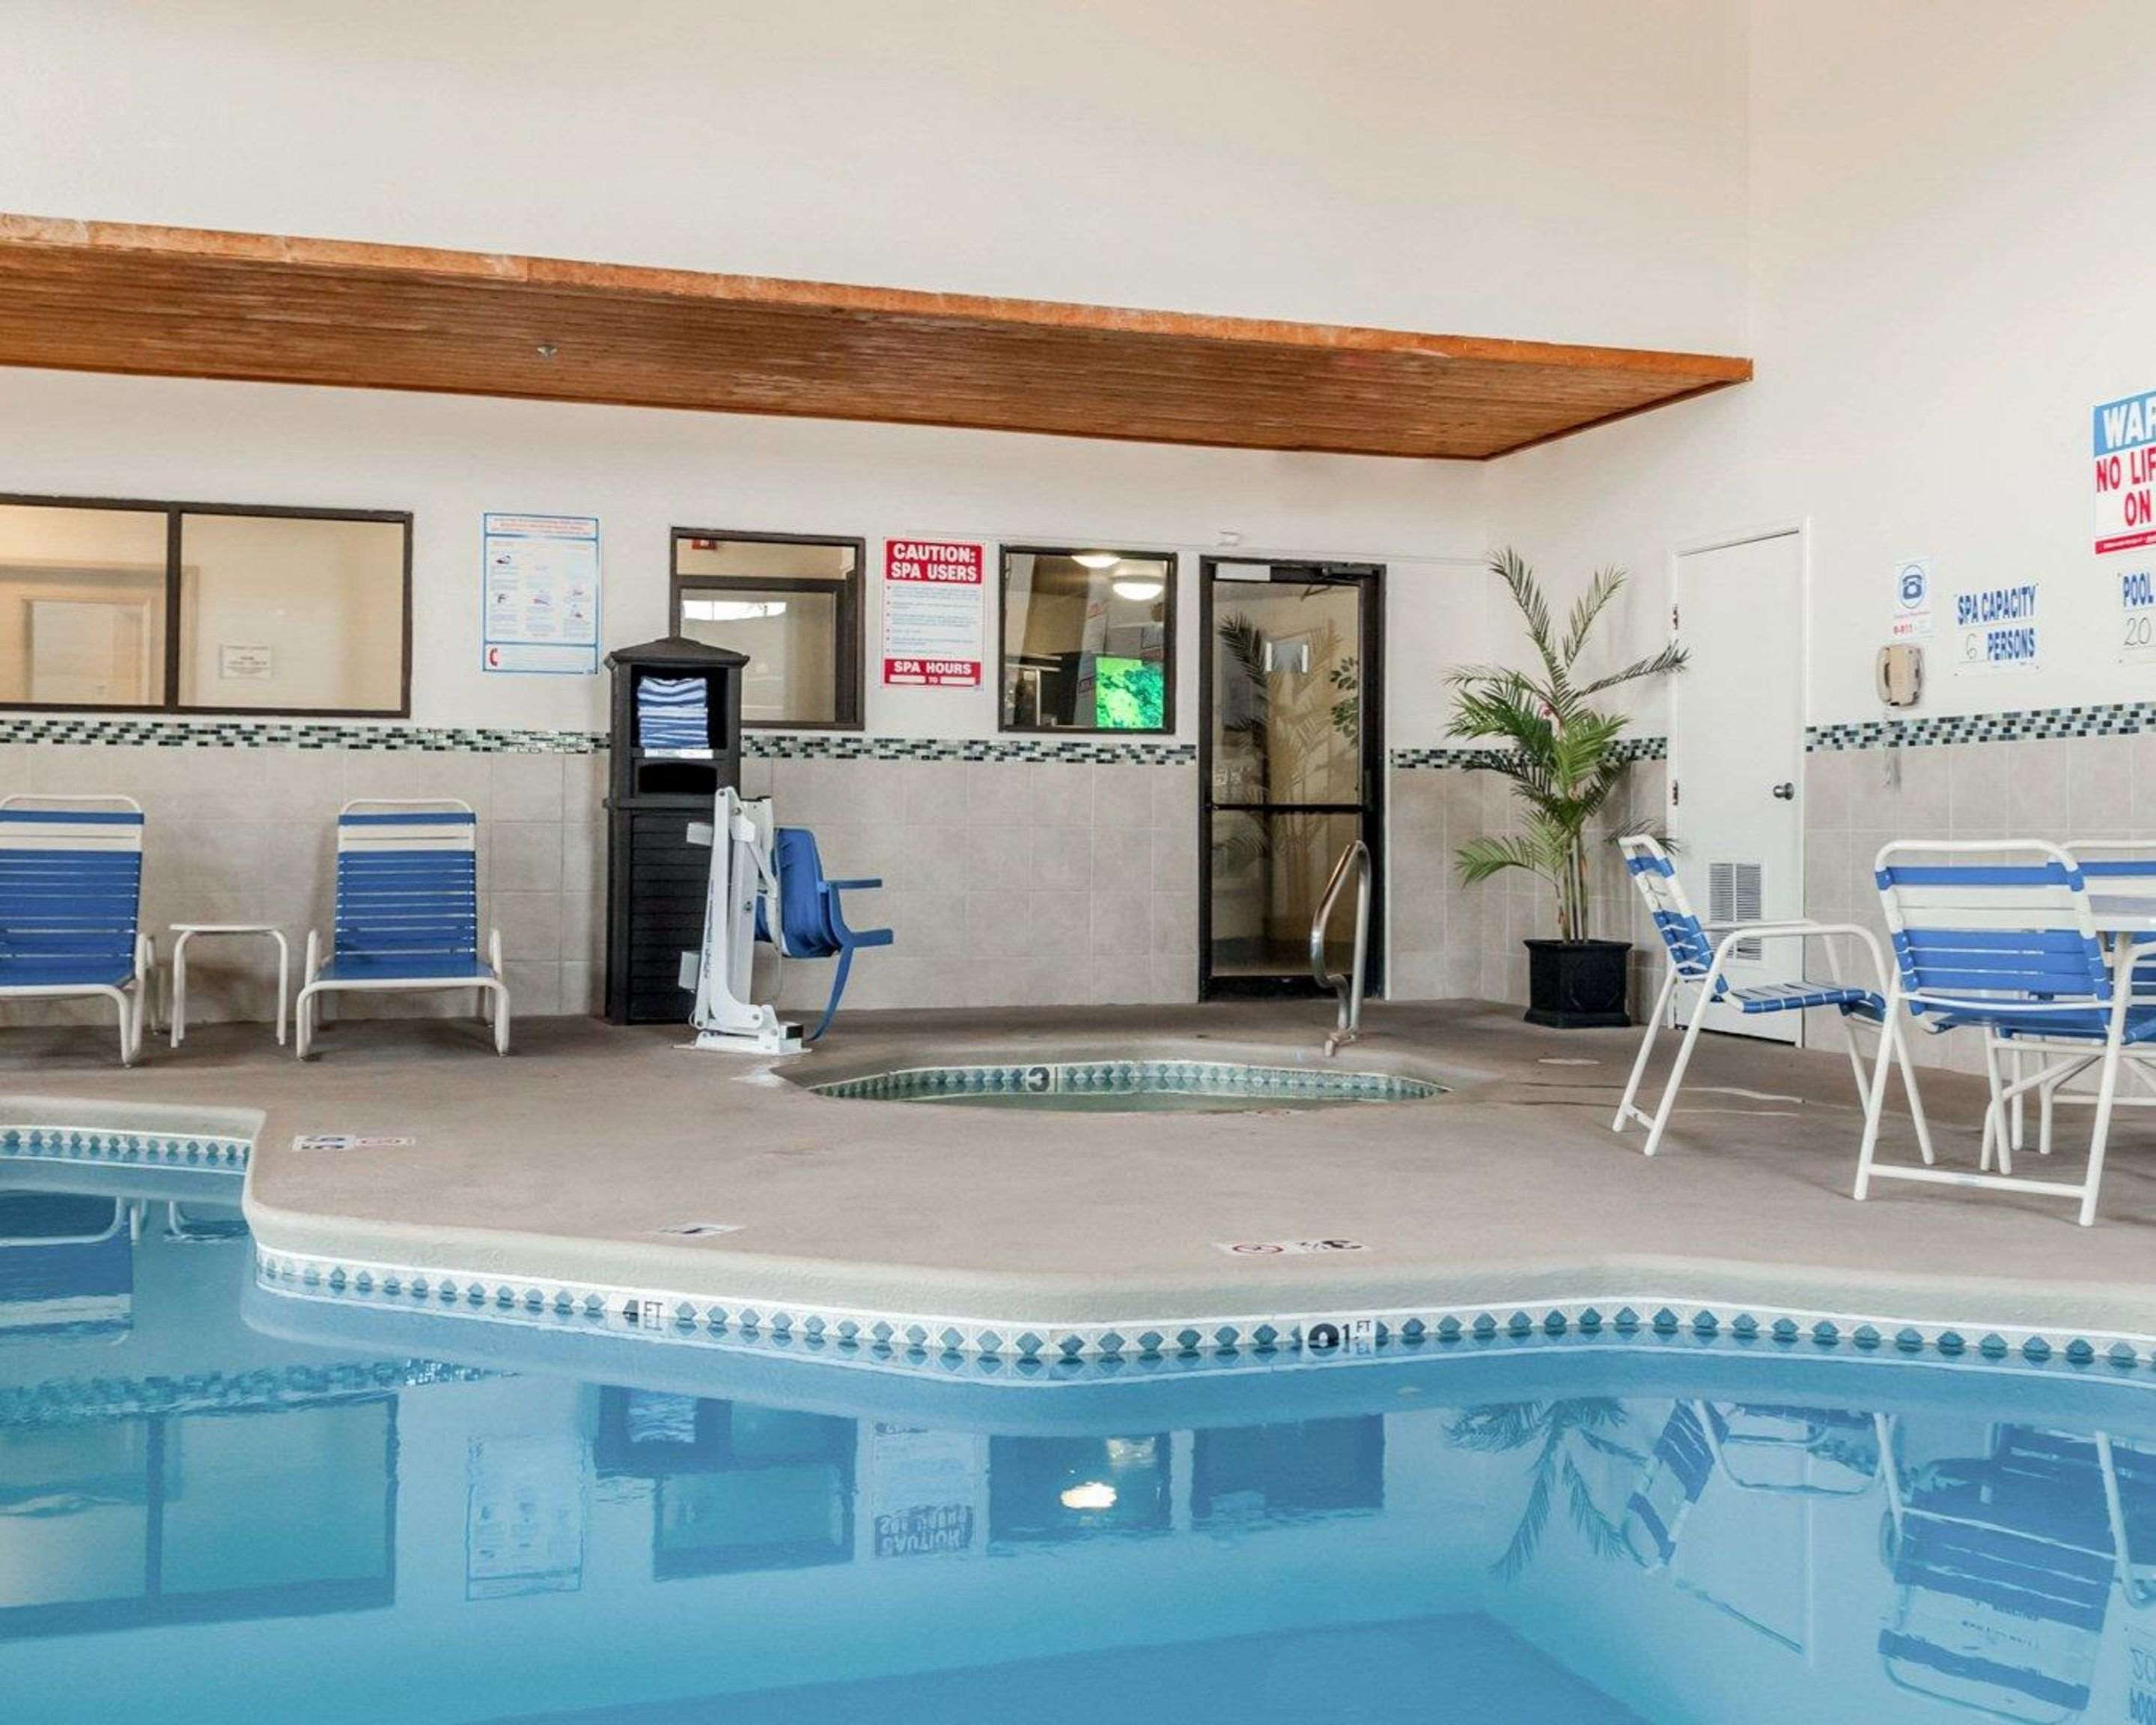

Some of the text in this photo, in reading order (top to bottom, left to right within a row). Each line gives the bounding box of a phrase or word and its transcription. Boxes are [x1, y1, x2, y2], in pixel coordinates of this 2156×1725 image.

[2096, 455, 2121, 493] NO
[2125, 489, 2152, 526] ON
[893, 543, 976, 563] CAUTION:
[891, 562, 977, 581] SPA USERS
[1958, 585, 2035, 625] SPA CAPACITY
[2123, 573, 2154, 607] POOL
[1988, 627, 2035, 660] PERSONS
[2123, 617, 2152, 646] 20
[894, 661, 972, 675] SPA HOURS
